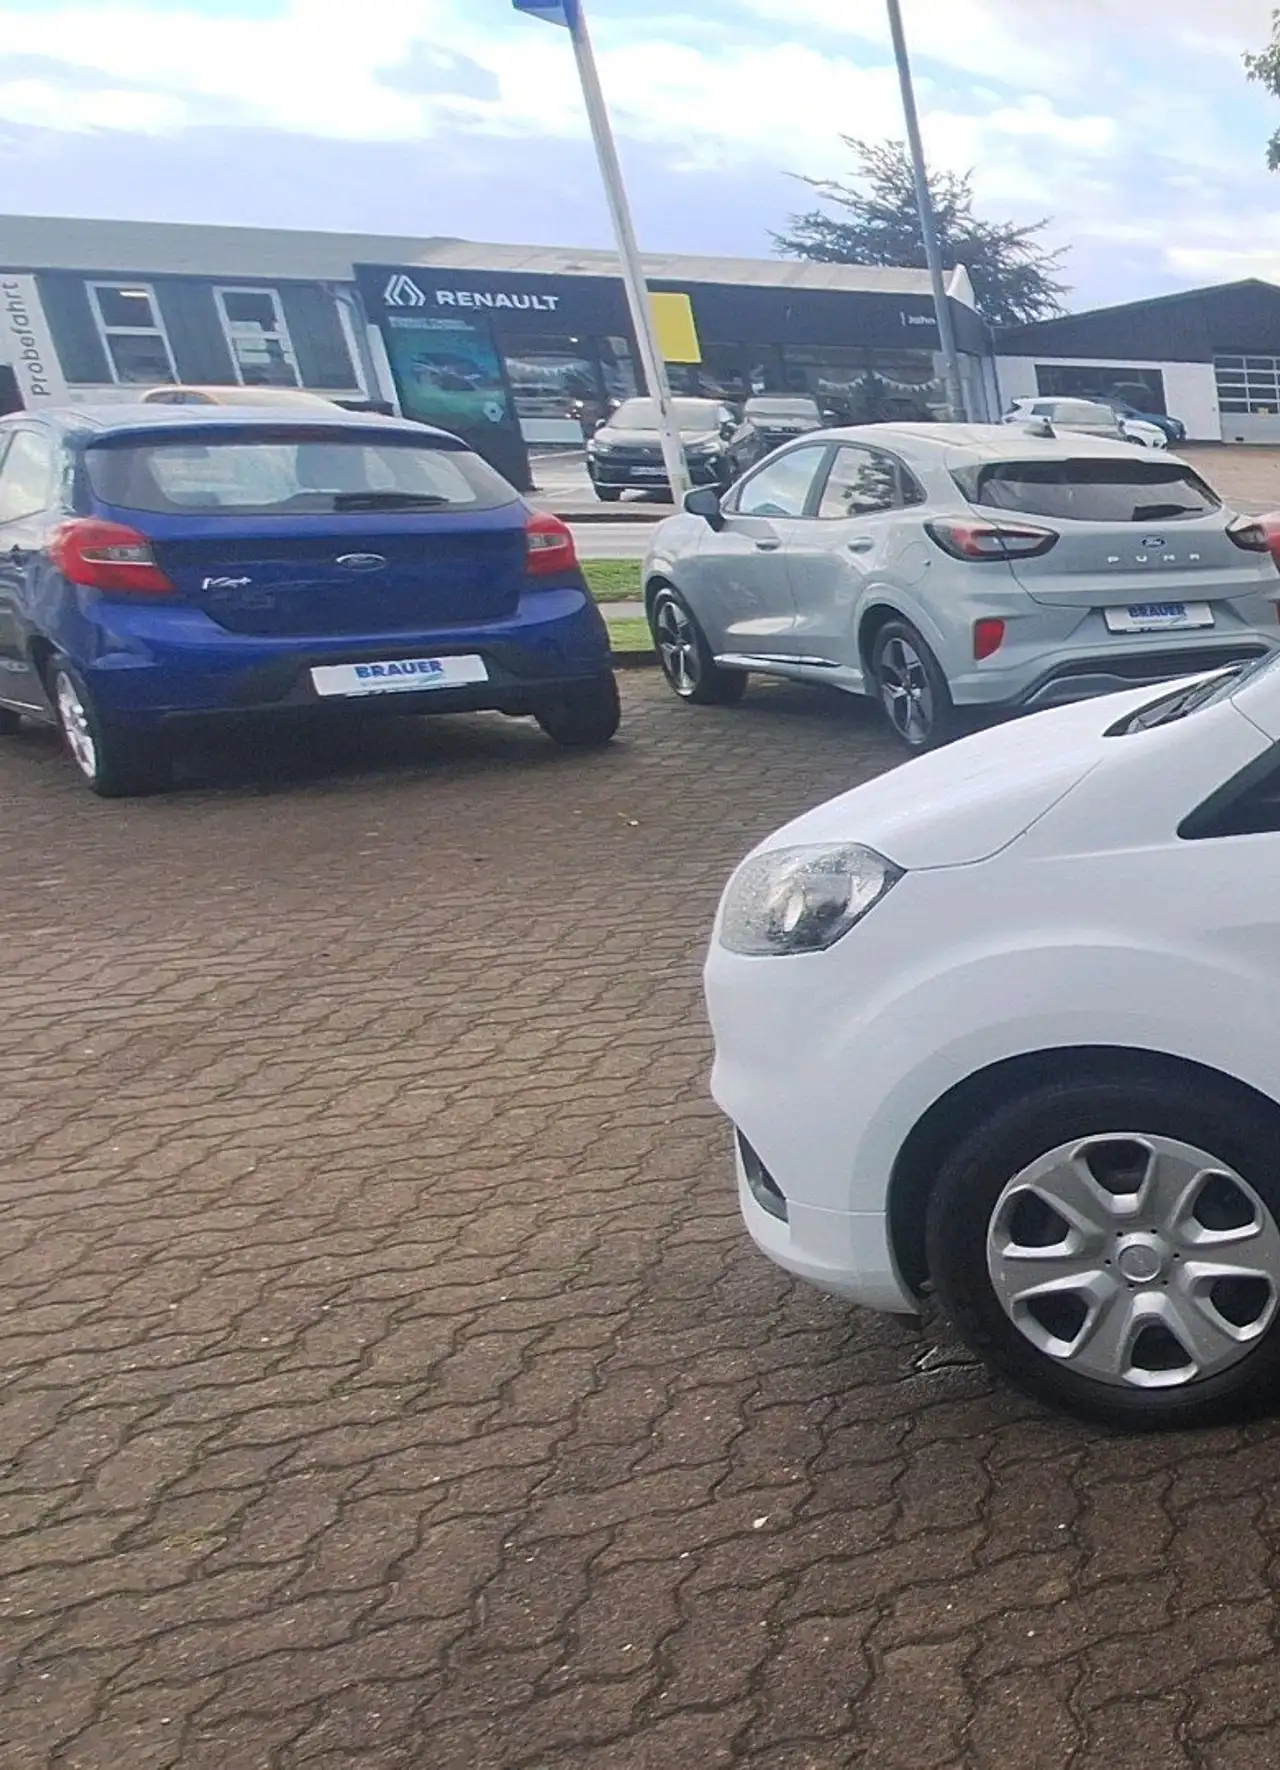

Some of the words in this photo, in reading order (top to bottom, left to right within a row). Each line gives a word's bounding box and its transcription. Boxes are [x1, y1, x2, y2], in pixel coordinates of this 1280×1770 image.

[435, 290, 559, 311] RENAULT
[1107, 553, 1200, 563] PUMA
[1128, 603, 1186, 618] BRAUER
[355, 660, 443, 679] BRAUER
